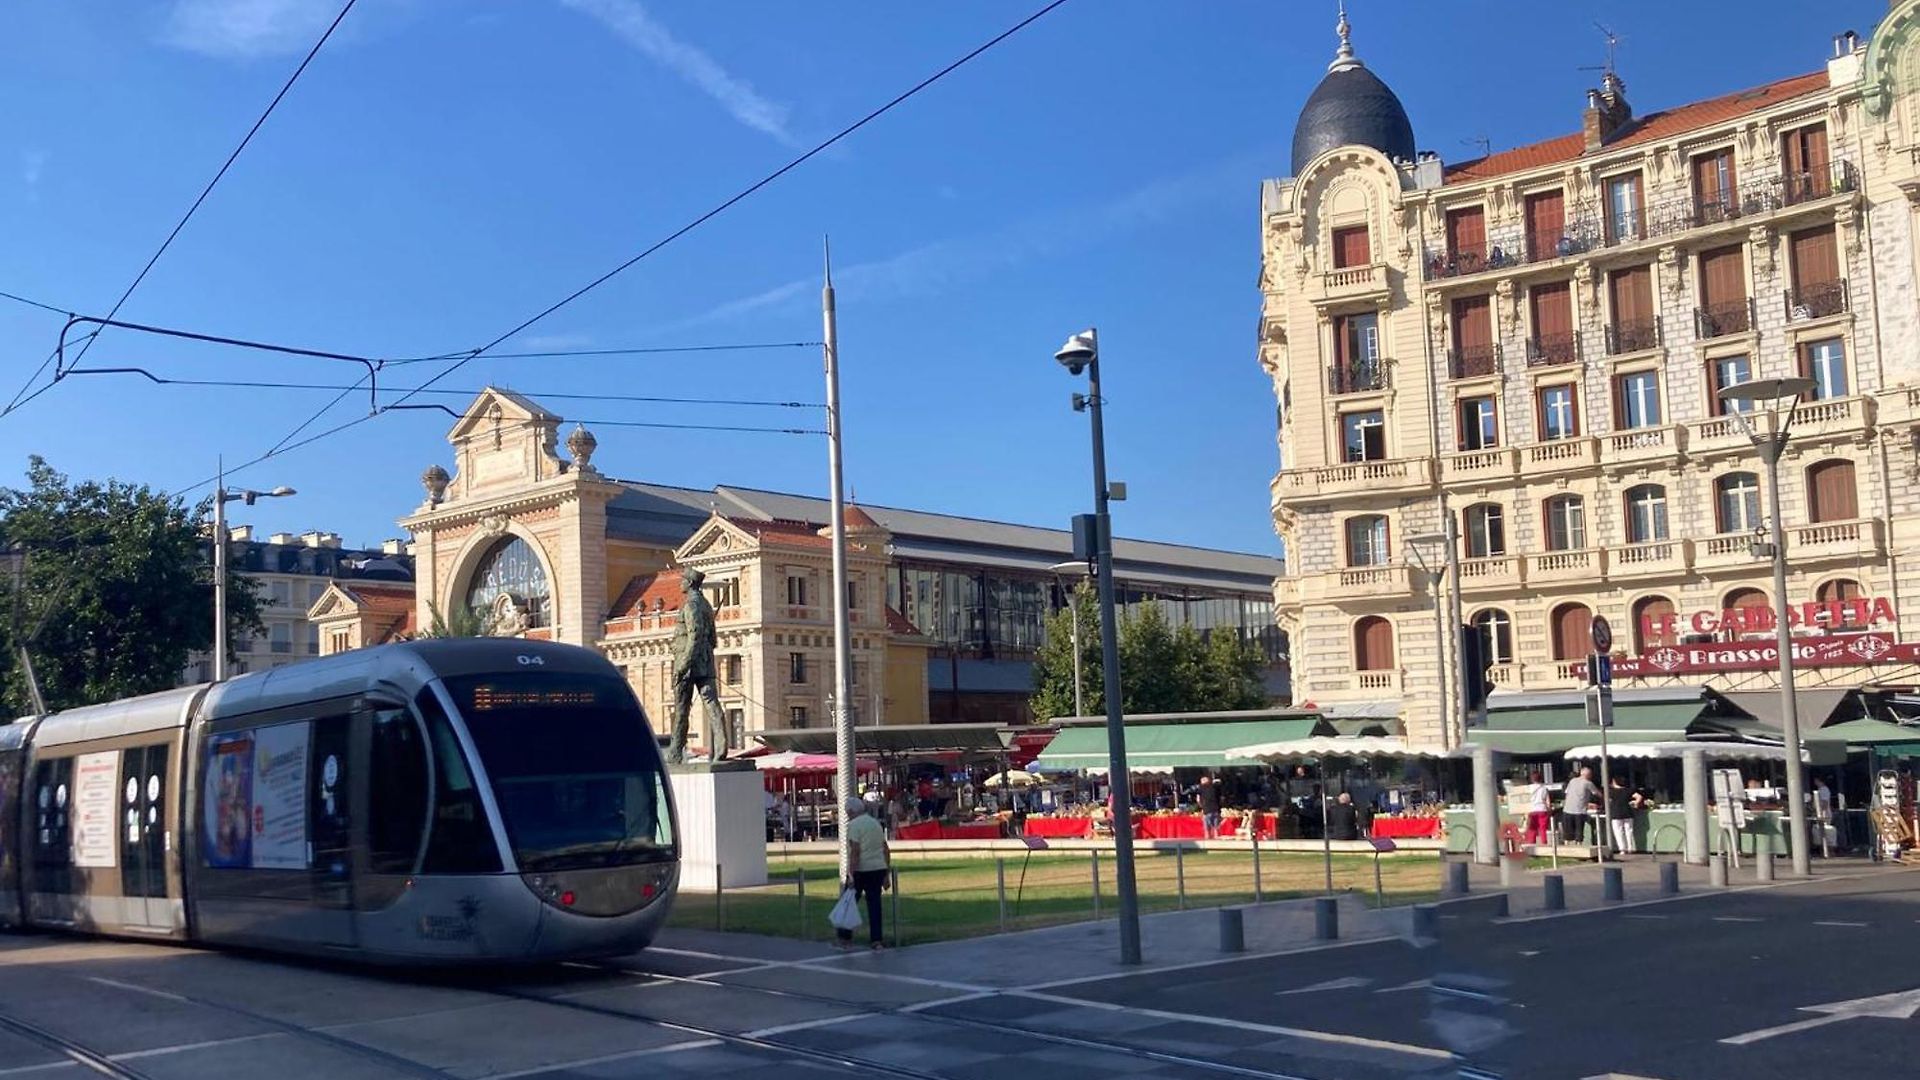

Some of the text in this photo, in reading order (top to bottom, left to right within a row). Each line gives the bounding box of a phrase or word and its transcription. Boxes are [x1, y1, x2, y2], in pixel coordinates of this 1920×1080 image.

[1642, 613, 1680, 637] LE
[516, 654, 545, 666] 04
[1689, 643, 1817, 665] Brasseie
